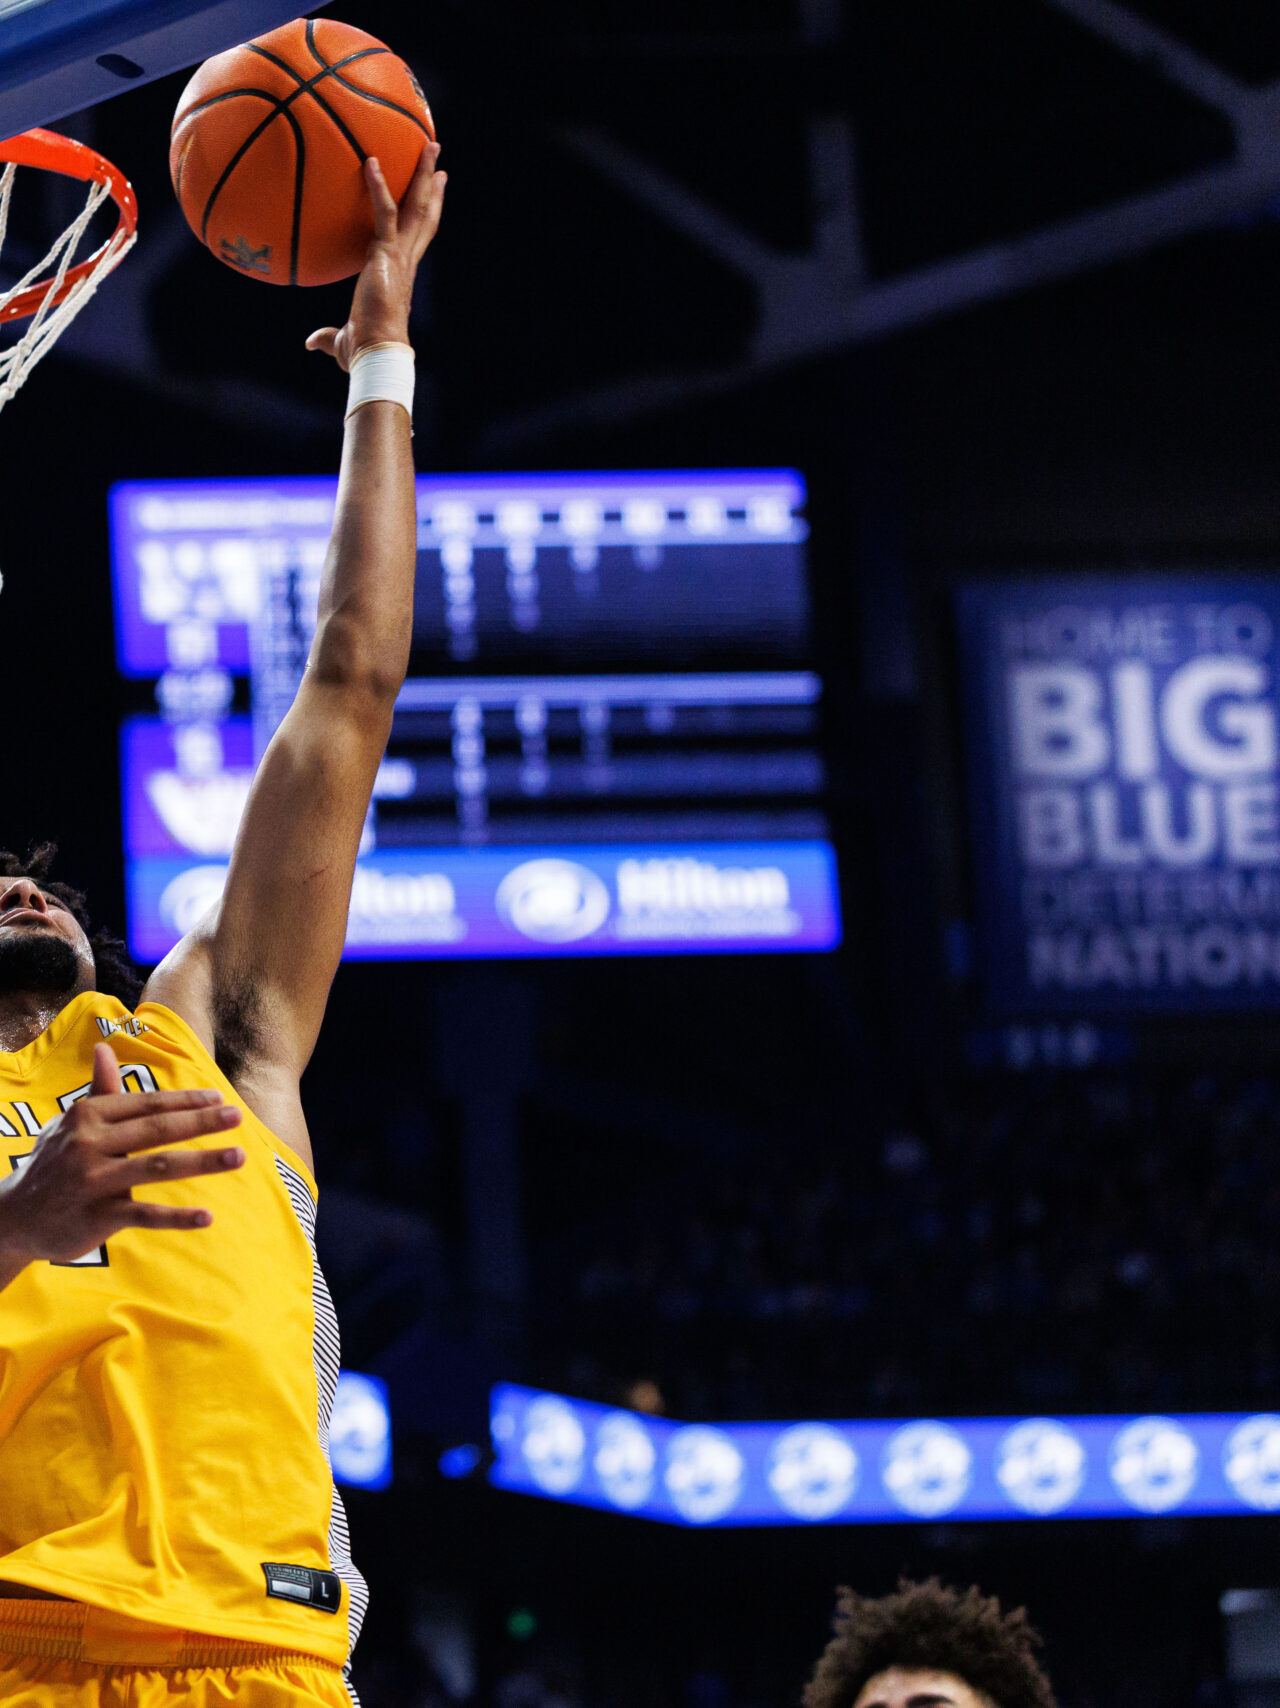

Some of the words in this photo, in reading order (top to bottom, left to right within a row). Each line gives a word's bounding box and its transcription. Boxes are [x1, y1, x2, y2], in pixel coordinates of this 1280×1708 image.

[1010, 655, 1277, 780] BIG
[1021, 780, 1280, 868] BLUE
[321, 1581, 330, 1599] L
